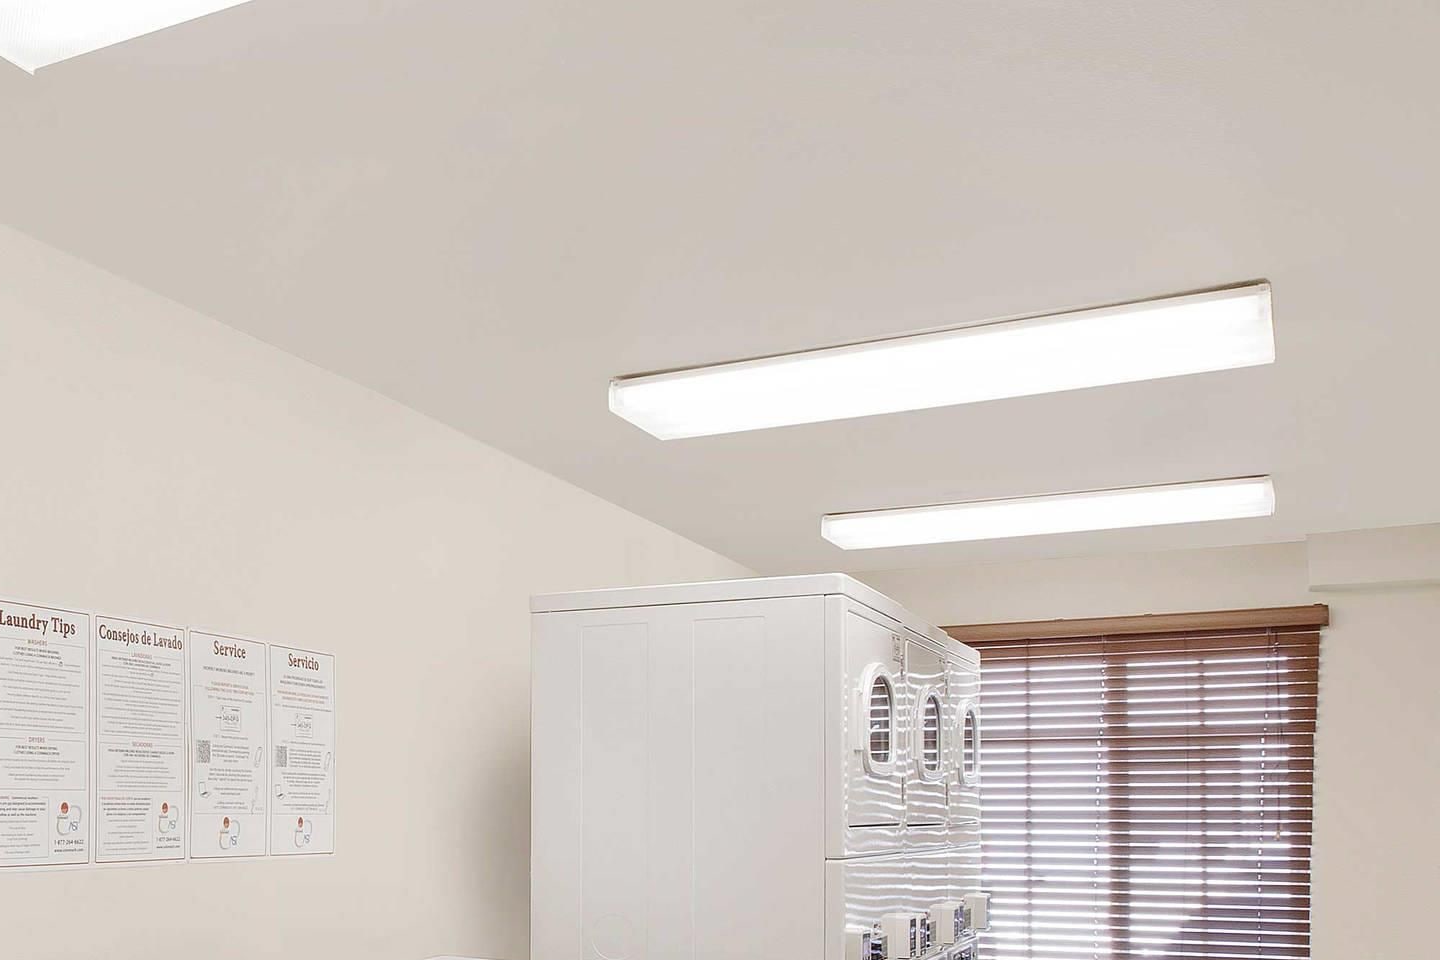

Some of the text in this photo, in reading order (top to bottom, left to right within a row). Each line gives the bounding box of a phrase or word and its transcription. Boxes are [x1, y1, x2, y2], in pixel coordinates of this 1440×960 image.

[51, 618, 76, 638] Tips
[99, 624, 183, 650] Consejos de Lavado
[213, 640, 246, 659] Service
[287, 653, 320, 671] Servicio
